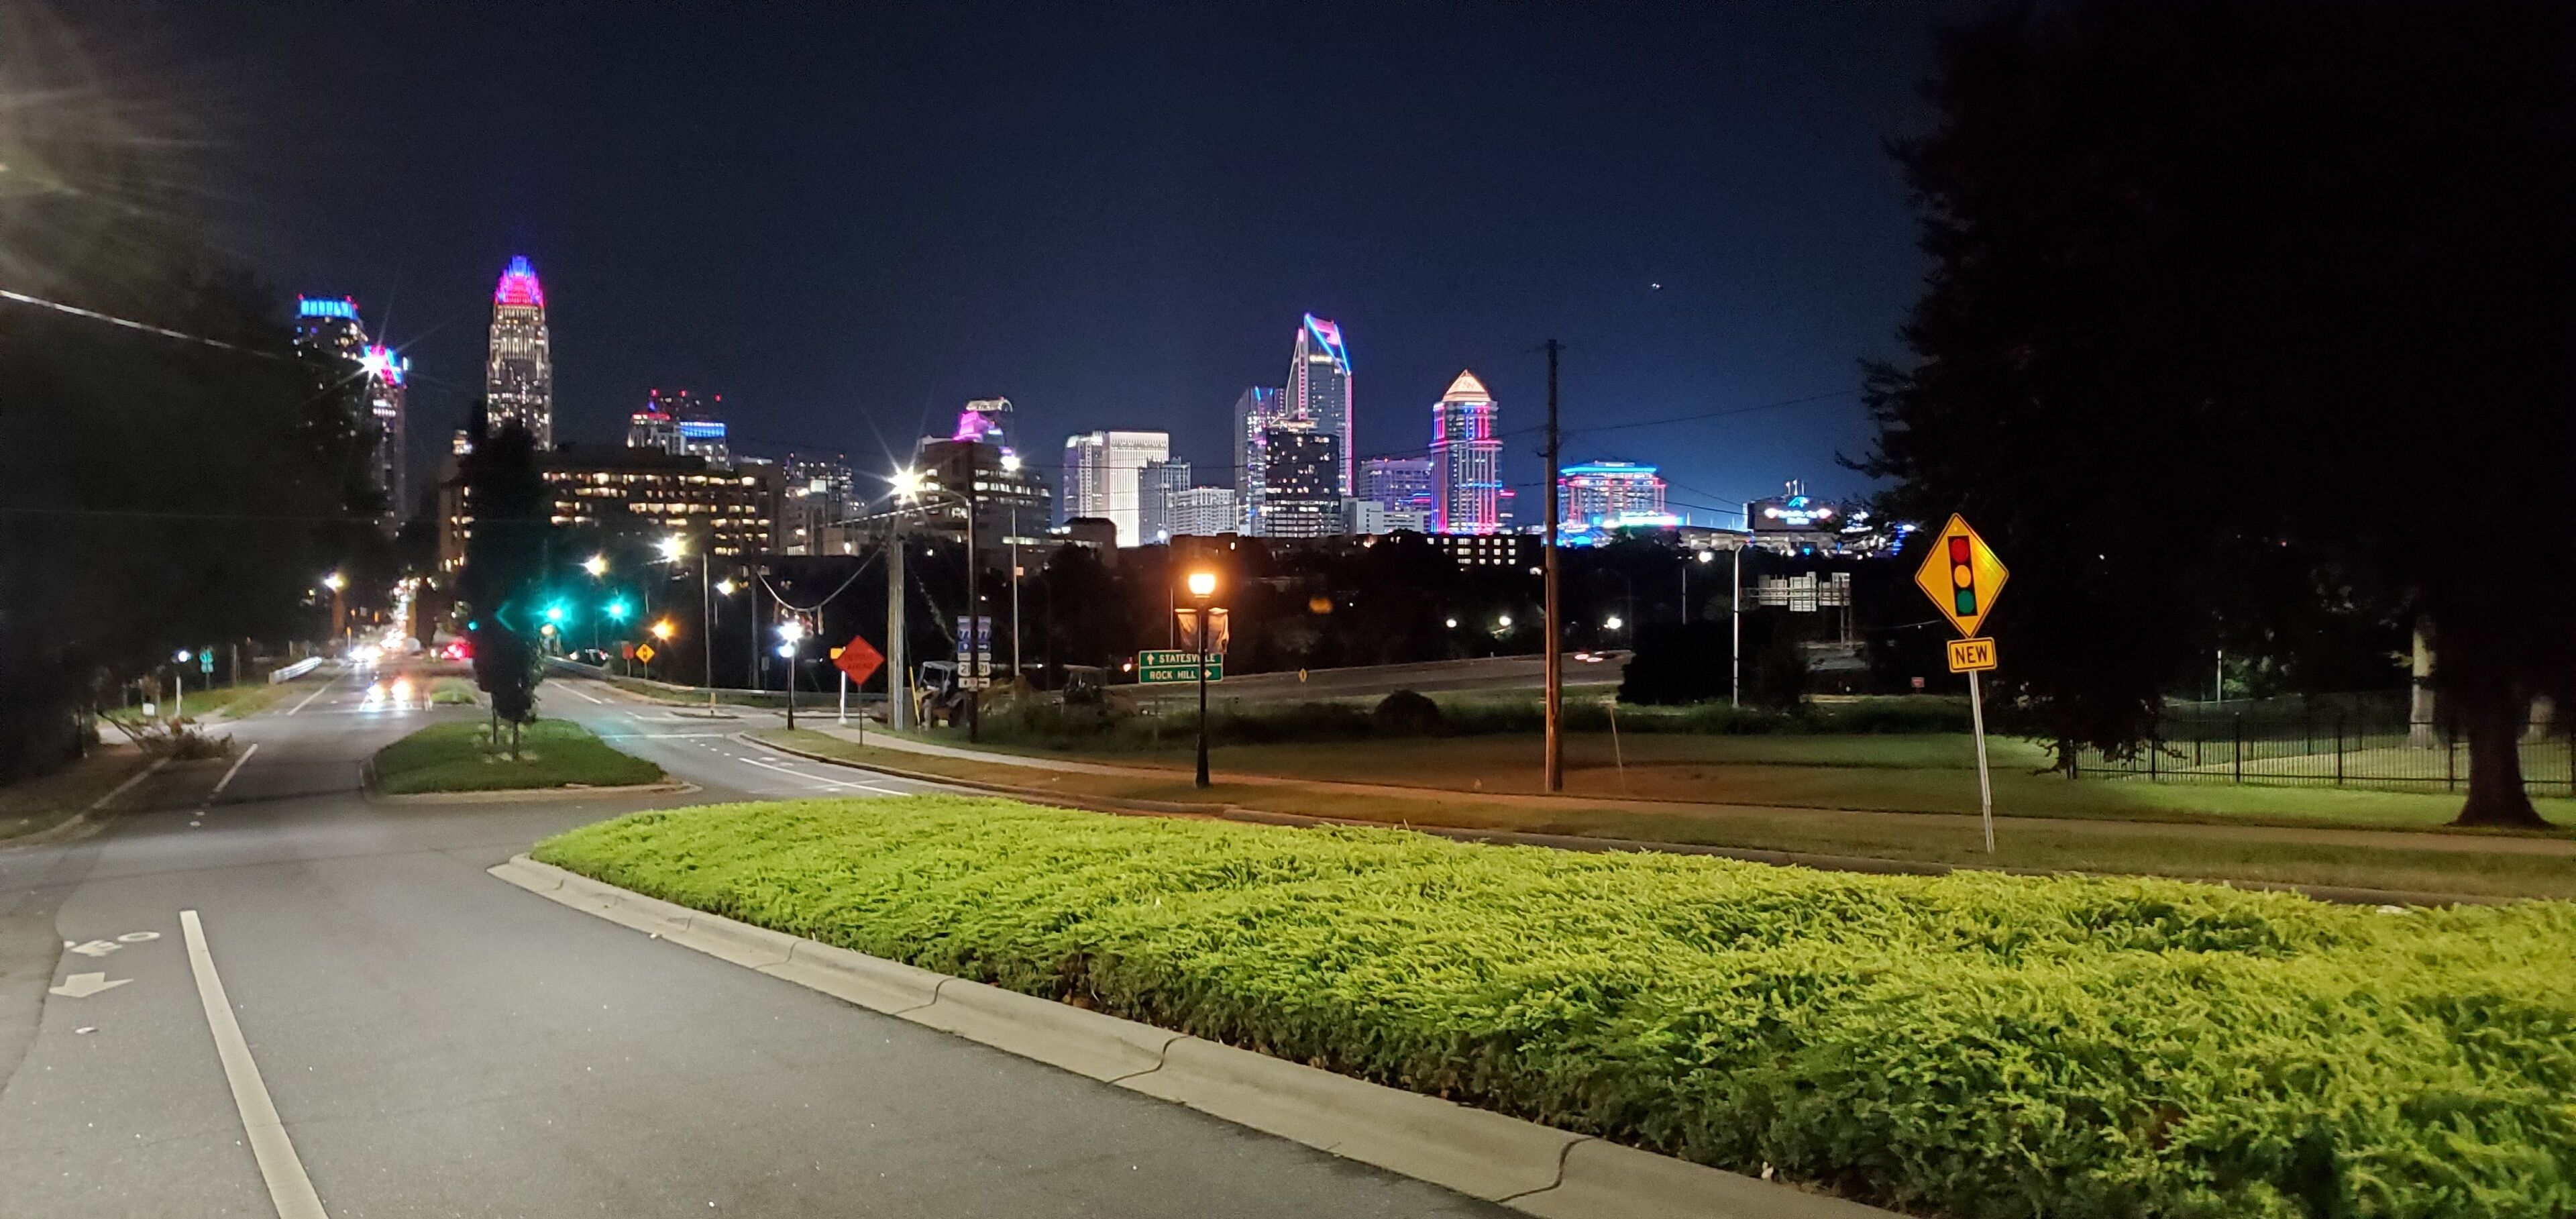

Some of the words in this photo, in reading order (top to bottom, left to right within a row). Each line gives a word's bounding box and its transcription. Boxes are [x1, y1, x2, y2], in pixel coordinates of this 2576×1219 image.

[1159, 653, 1216, 664] STATESVILE
[1955, 645, 1987, 665] NEW
[1150, 671, 1173, 680] ROCK
[1177, 670, 1197, 679] HILL
